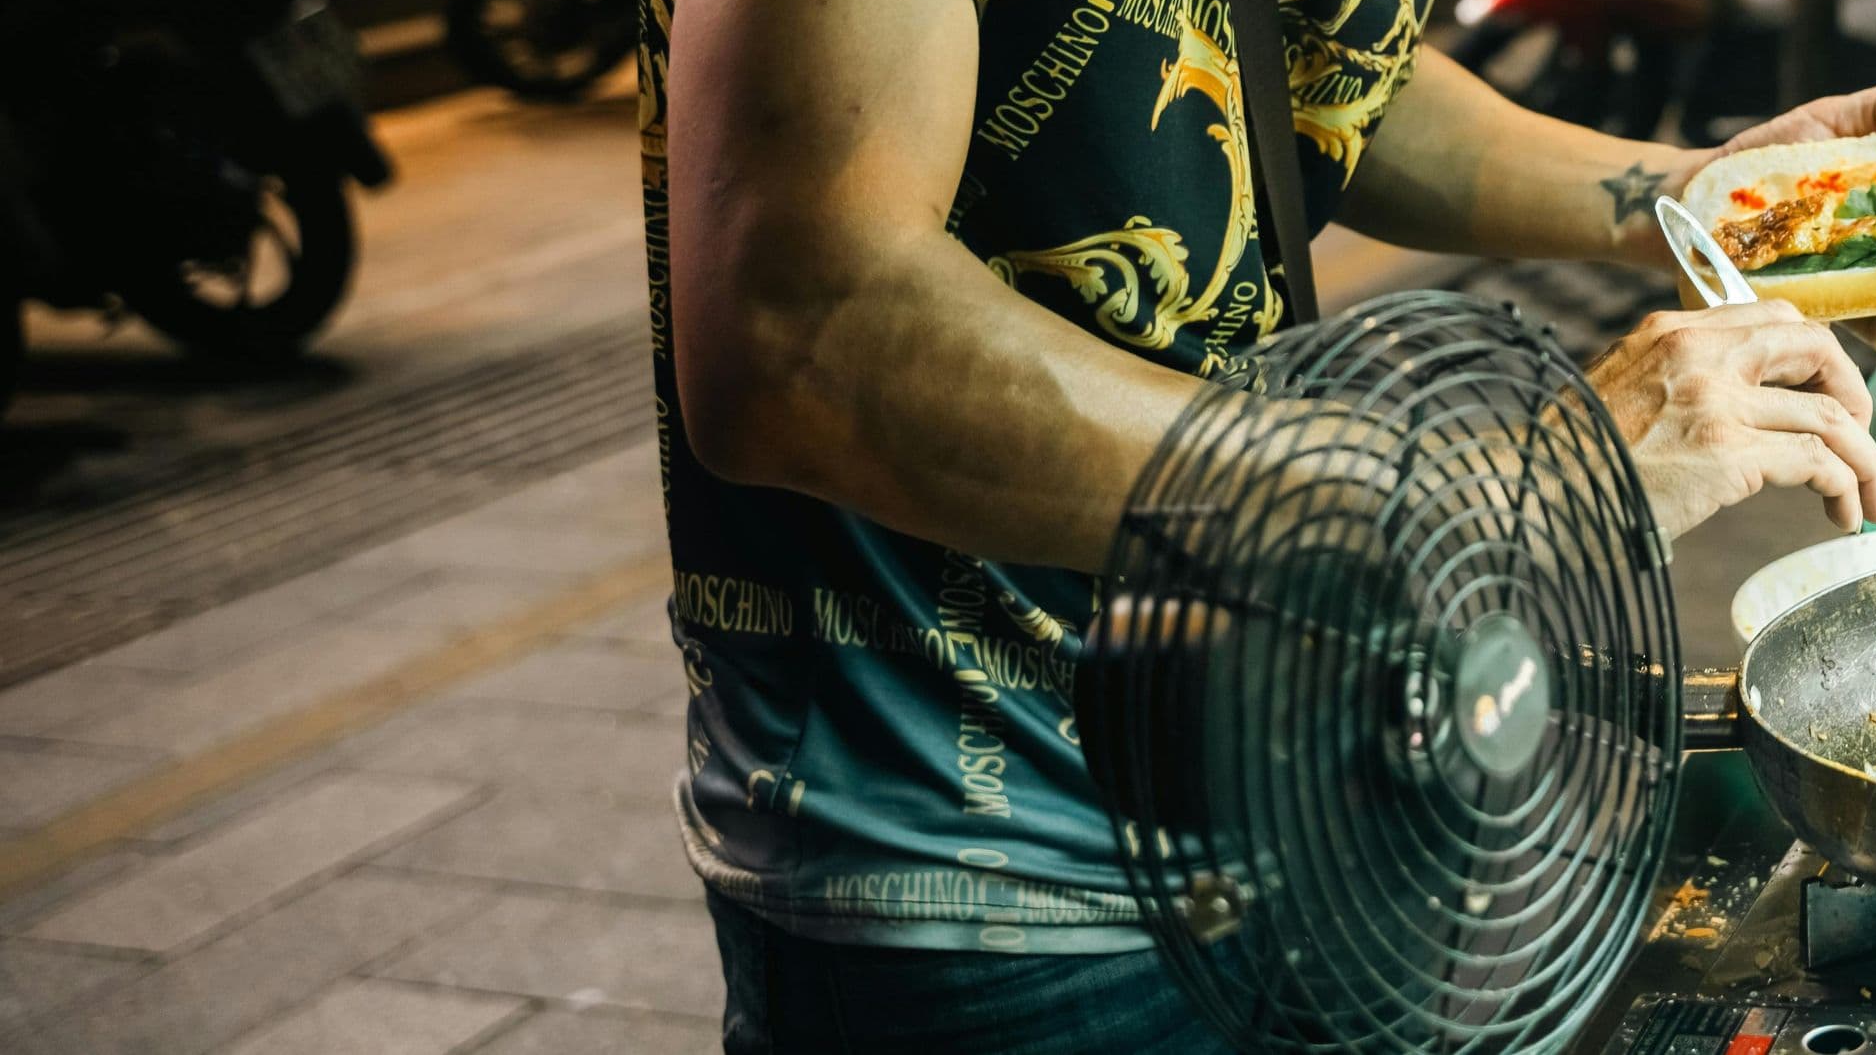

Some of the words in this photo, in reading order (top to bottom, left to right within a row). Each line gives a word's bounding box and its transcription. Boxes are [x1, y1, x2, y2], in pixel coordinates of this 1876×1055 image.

[977, 7, 1111, 161] MOSCHINO
[674, 567, 793, 636] MOSCHINO
[825, 870, 976, 925] MOSCHINO
